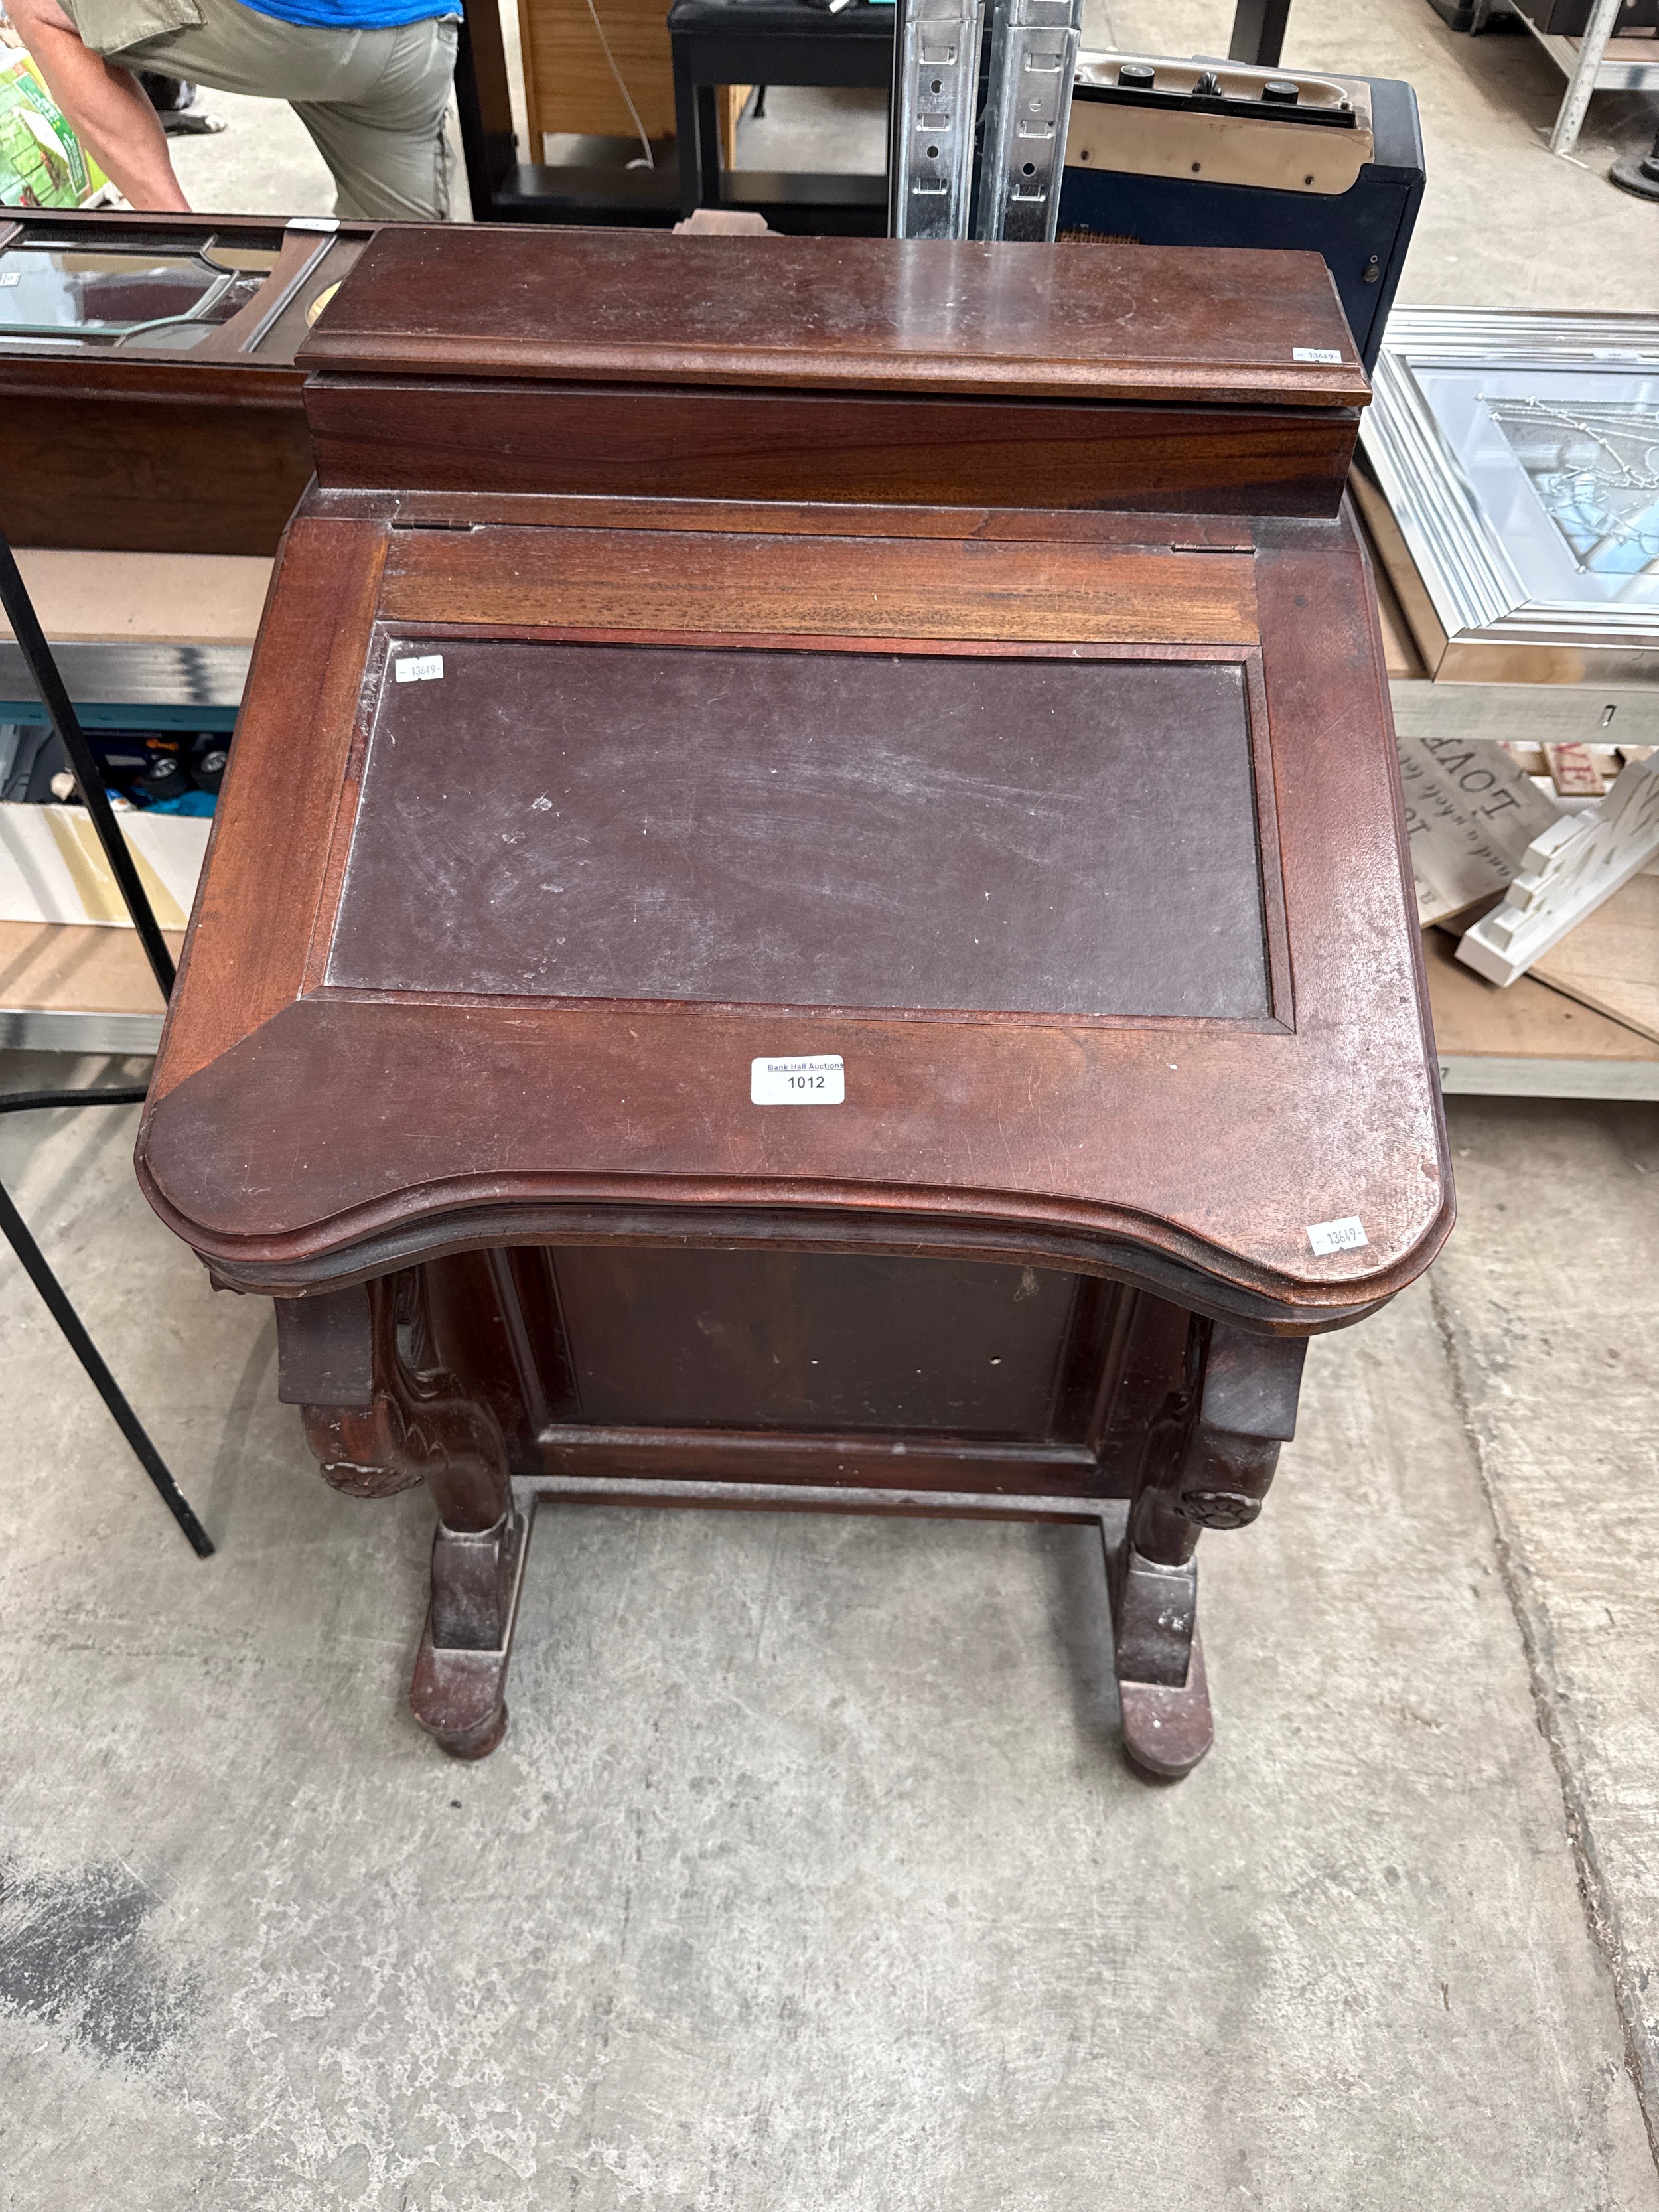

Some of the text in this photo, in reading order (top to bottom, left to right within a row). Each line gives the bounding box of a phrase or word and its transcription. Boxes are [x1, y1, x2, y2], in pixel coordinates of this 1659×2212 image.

[808, 1062, 845, 1070] Auctions
[788, 1076, 825, 1088] 1012
[1327, 1227, 1356, 1246] 13649
